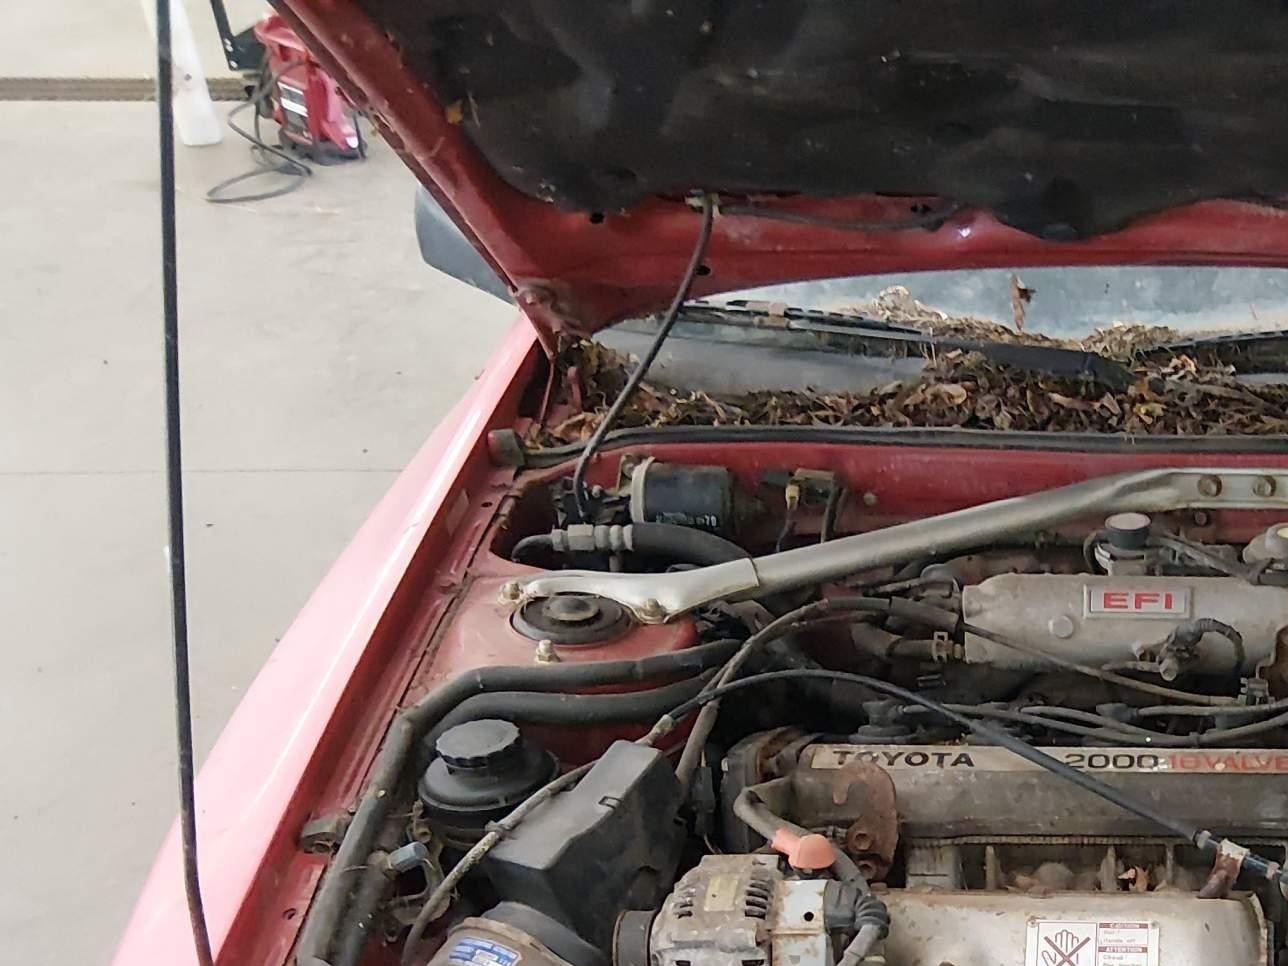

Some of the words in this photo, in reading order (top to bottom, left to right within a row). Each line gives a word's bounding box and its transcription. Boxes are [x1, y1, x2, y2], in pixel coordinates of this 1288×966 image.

[1103, 591, 1172, 610] EFI
[832, 750, 975, 768] TOYOTA
[1065, 753, 1159, 770] 2000
